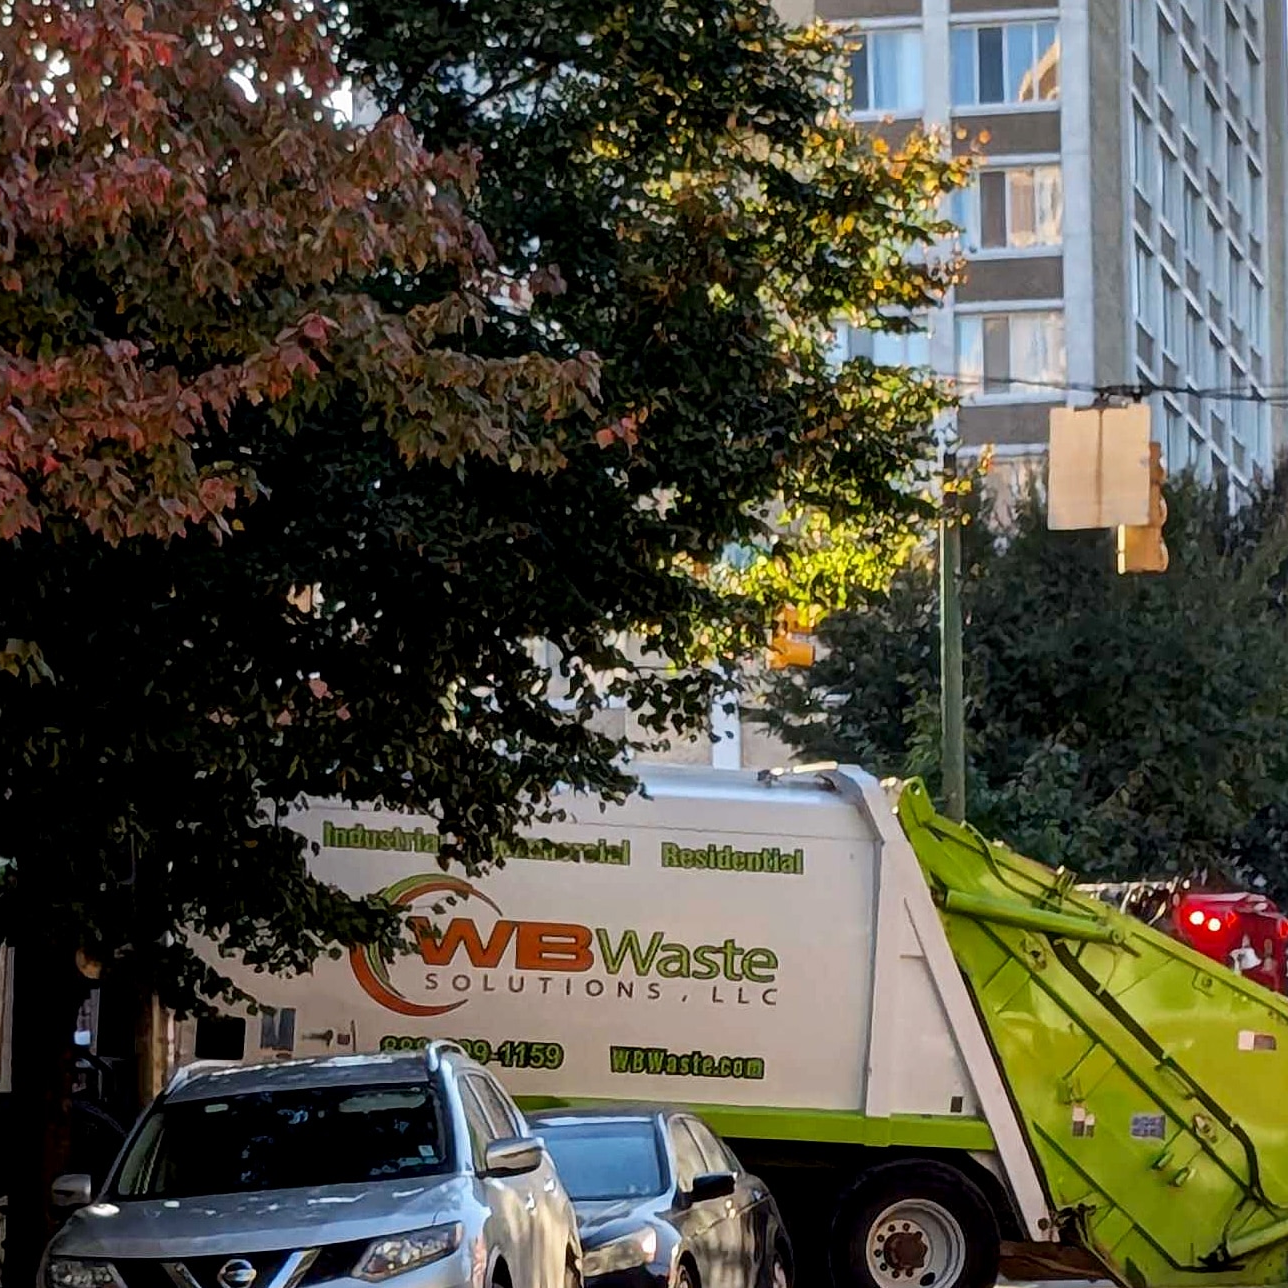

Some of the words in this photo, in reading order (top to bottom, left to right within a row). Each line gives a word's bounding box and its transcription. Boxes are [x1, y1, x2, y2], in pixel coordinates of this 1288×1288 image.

[661, 842, 804, 876] Residential
[711, 986, 779, 1007] LLC
[610, 1045, 766, 1079] WBWaste.com
